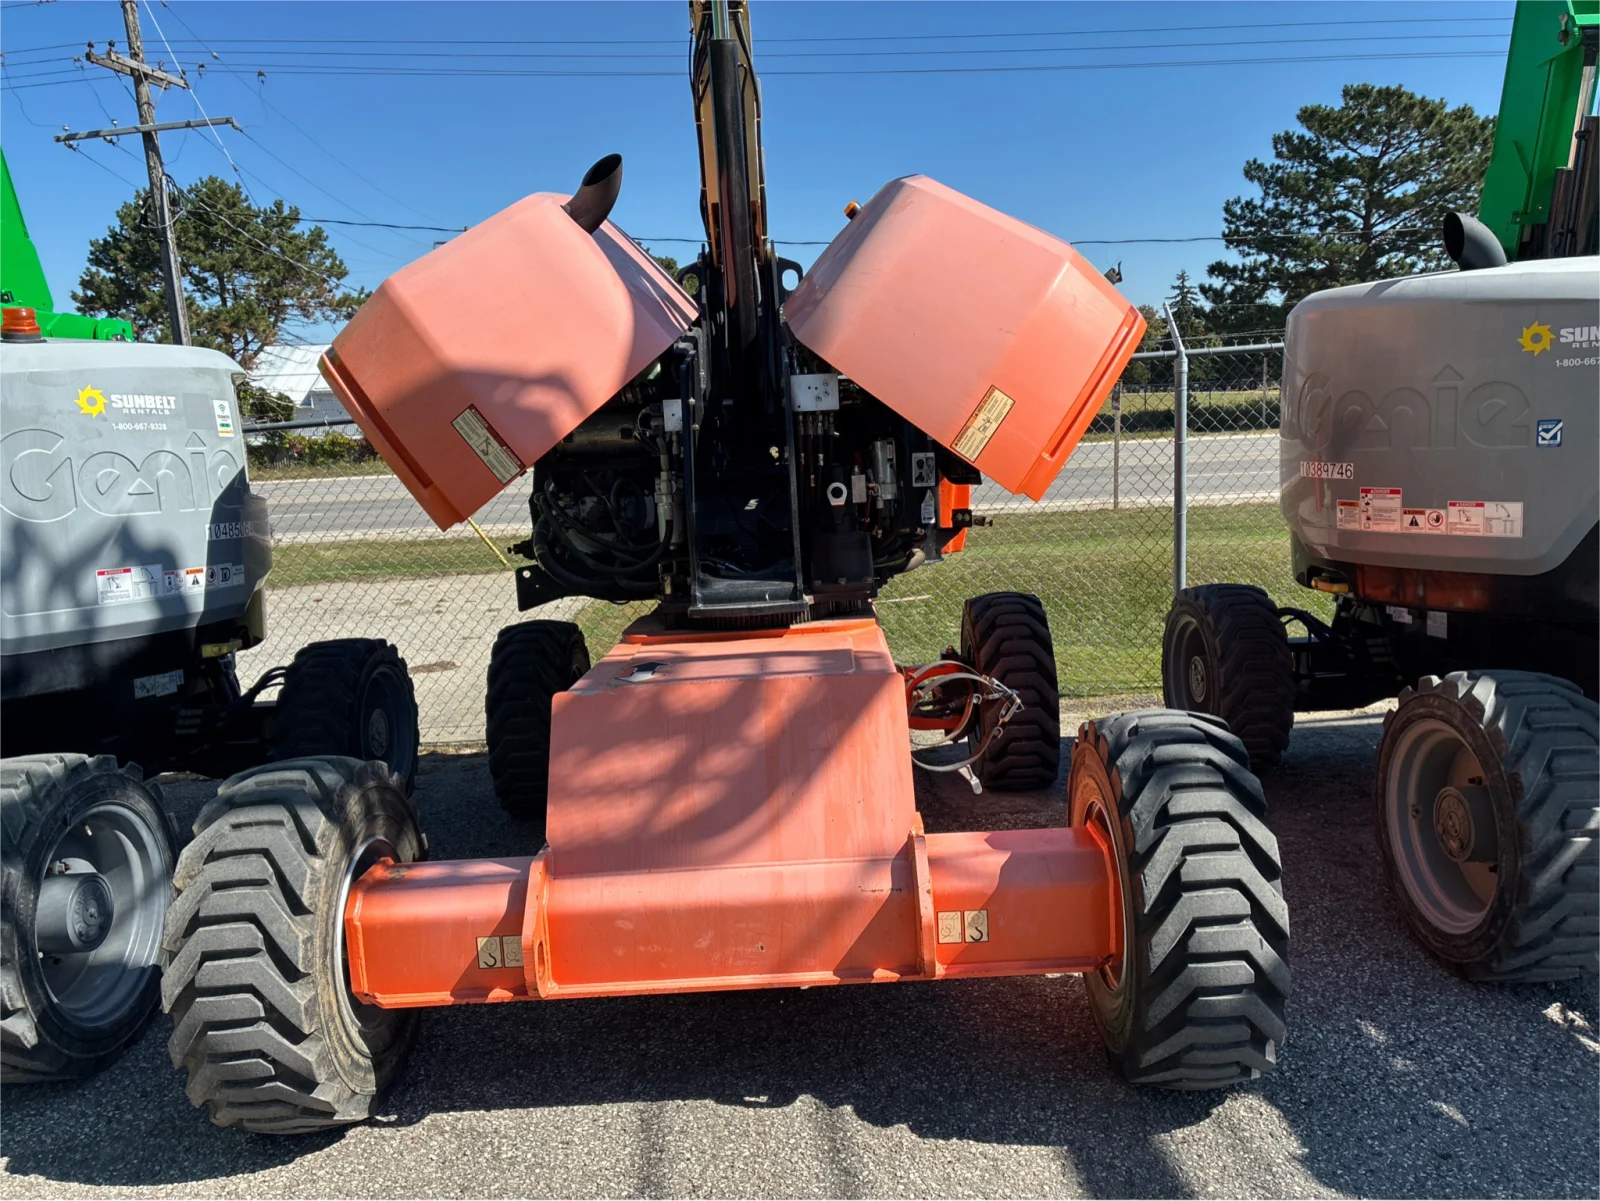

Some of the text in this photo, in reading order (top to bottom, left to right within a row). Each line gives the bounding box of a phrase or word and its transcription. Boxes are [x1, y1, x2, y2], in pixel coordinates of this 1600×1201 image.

[110, 394, 176, 409] SUNBELT
[1298, 365, 1530, 451] Genie
[111, 422, 167, 431] 1-800-667-9328
[0, 429, 247, 522] Genie
[1301, 462, 1353, 479] 10389746
